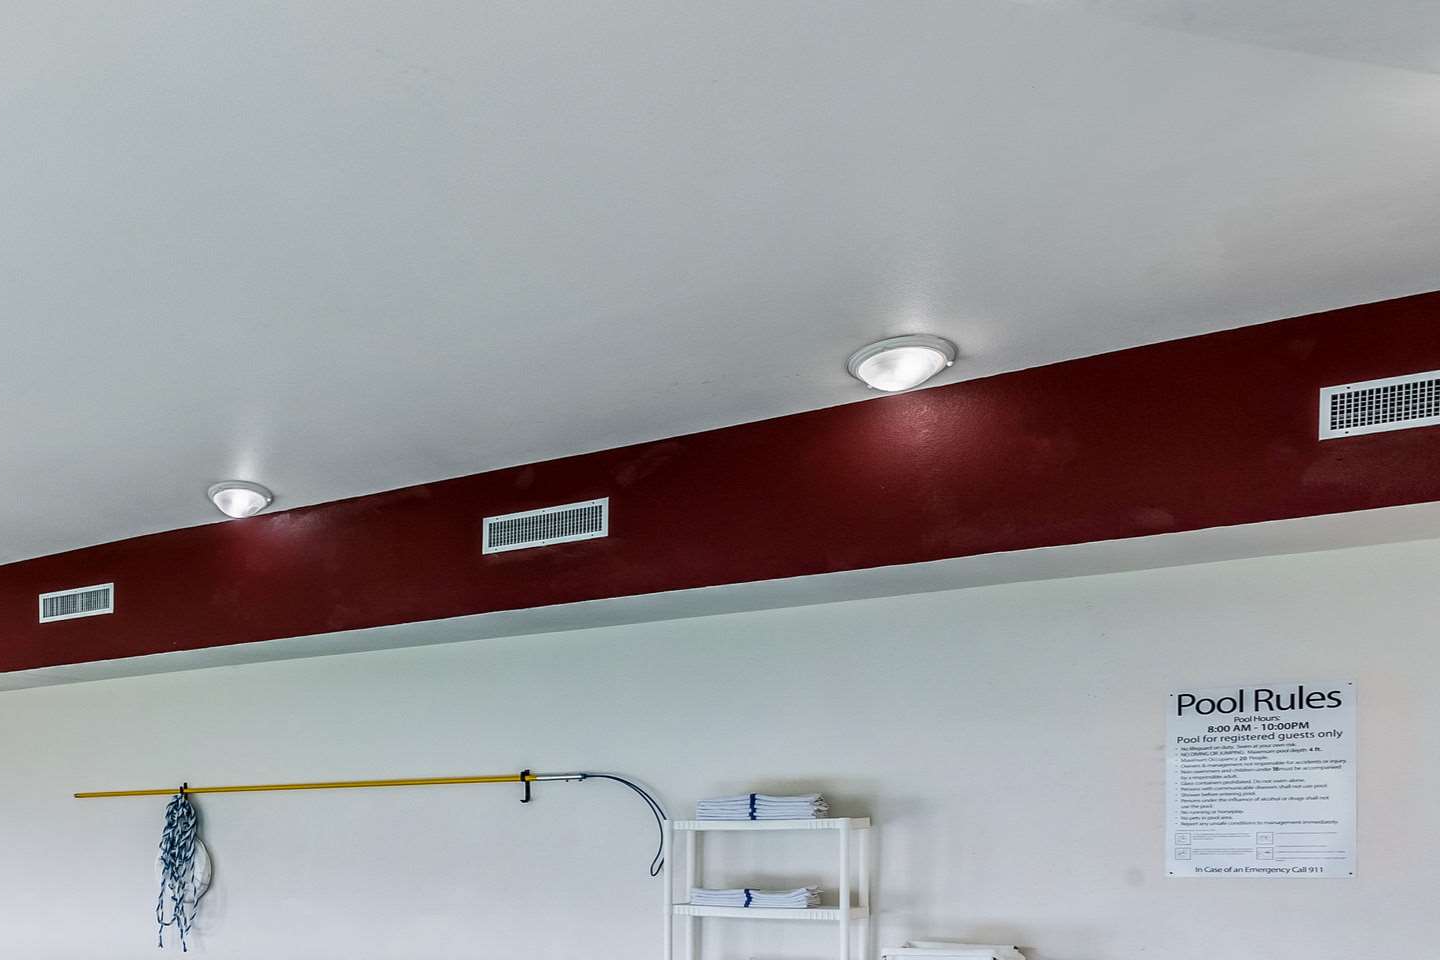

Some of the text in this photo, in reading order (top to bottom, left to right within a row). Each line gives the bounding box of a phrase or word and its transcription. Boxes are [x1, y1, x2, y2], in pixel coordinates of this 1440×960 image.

[1177, 685, 1342, 716] Pool Rules
[1233, 715, 1280, 723] Pool Hours:
[1207, 725, 1231, 733] 8:00
[1233, 724, 1252, 732] AM
[1261, 721, 1310, 731] 10:00PM
[1177, 729, 1343, 745] Pool for registered guests only
[1245, 866, 1290, 875] Emergency
